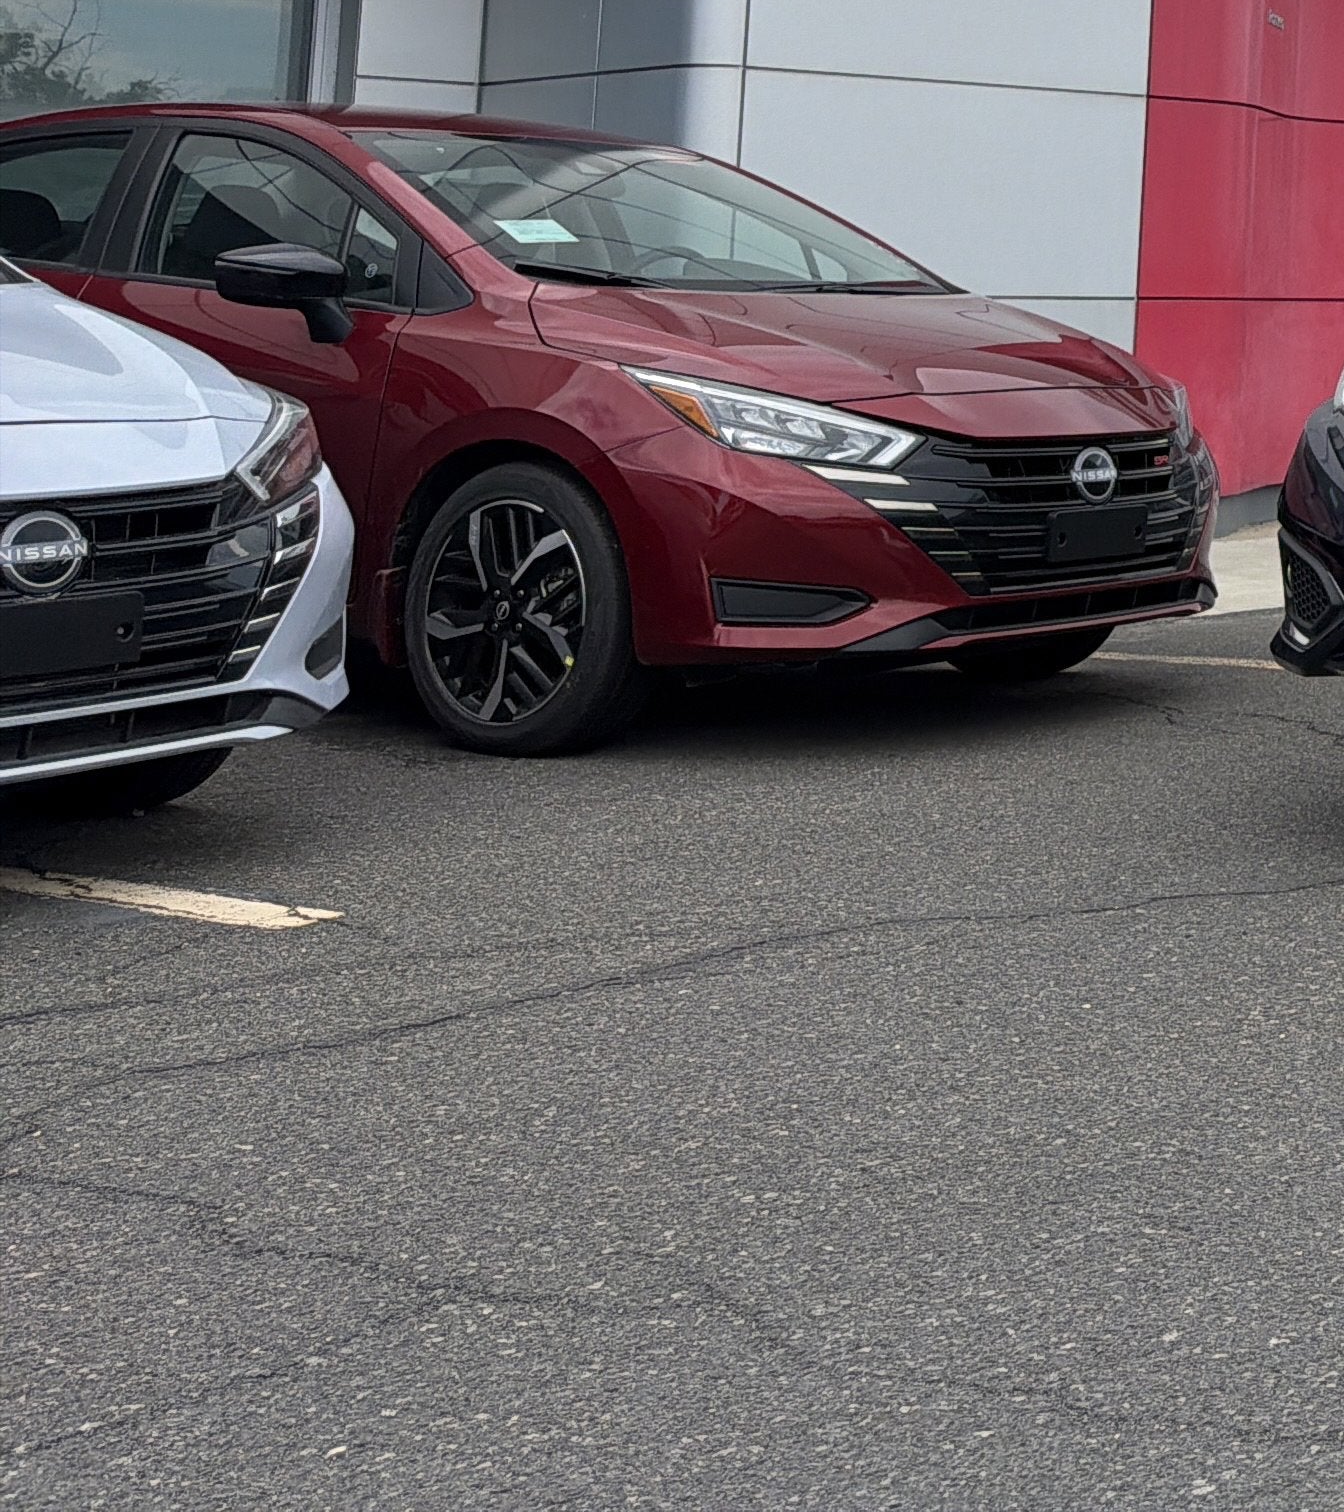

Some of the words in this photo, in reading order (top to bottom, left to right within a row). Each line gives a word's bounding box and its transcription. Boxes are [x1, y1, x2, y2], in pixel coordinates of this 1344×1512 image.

[1153, 455, 1169, 466] SR
[1072, 469, 1116, 481] NISSAN
[0, 543, 87, 561] NISSAN
